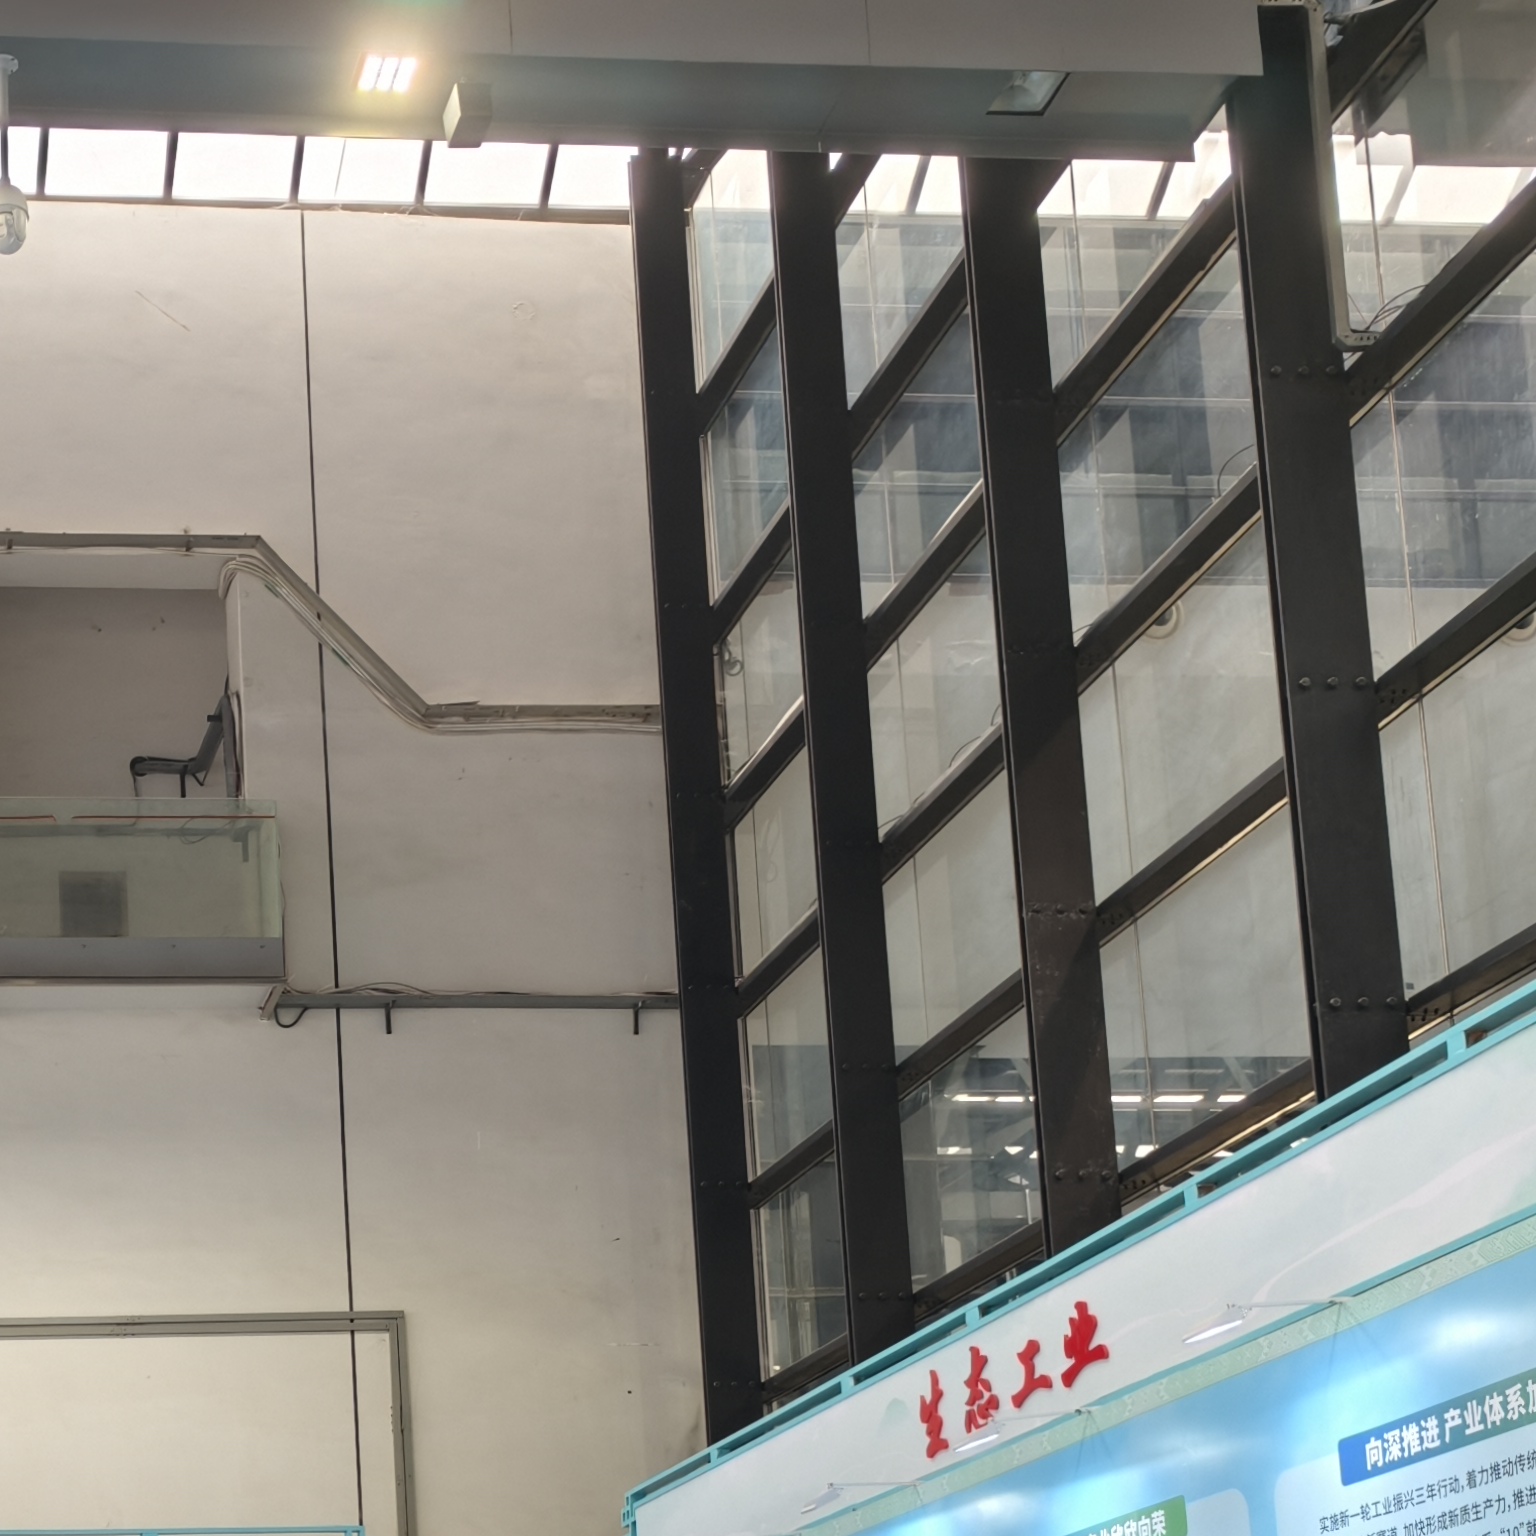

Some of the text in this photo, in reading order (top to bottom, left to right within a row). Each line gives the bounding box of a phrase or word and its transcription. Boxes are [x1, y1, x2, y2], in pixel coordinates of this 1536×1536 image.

[919, 1301, 1110, 1459] 生态工业
[1365, 1414, 1441, 1471] 向深推进
